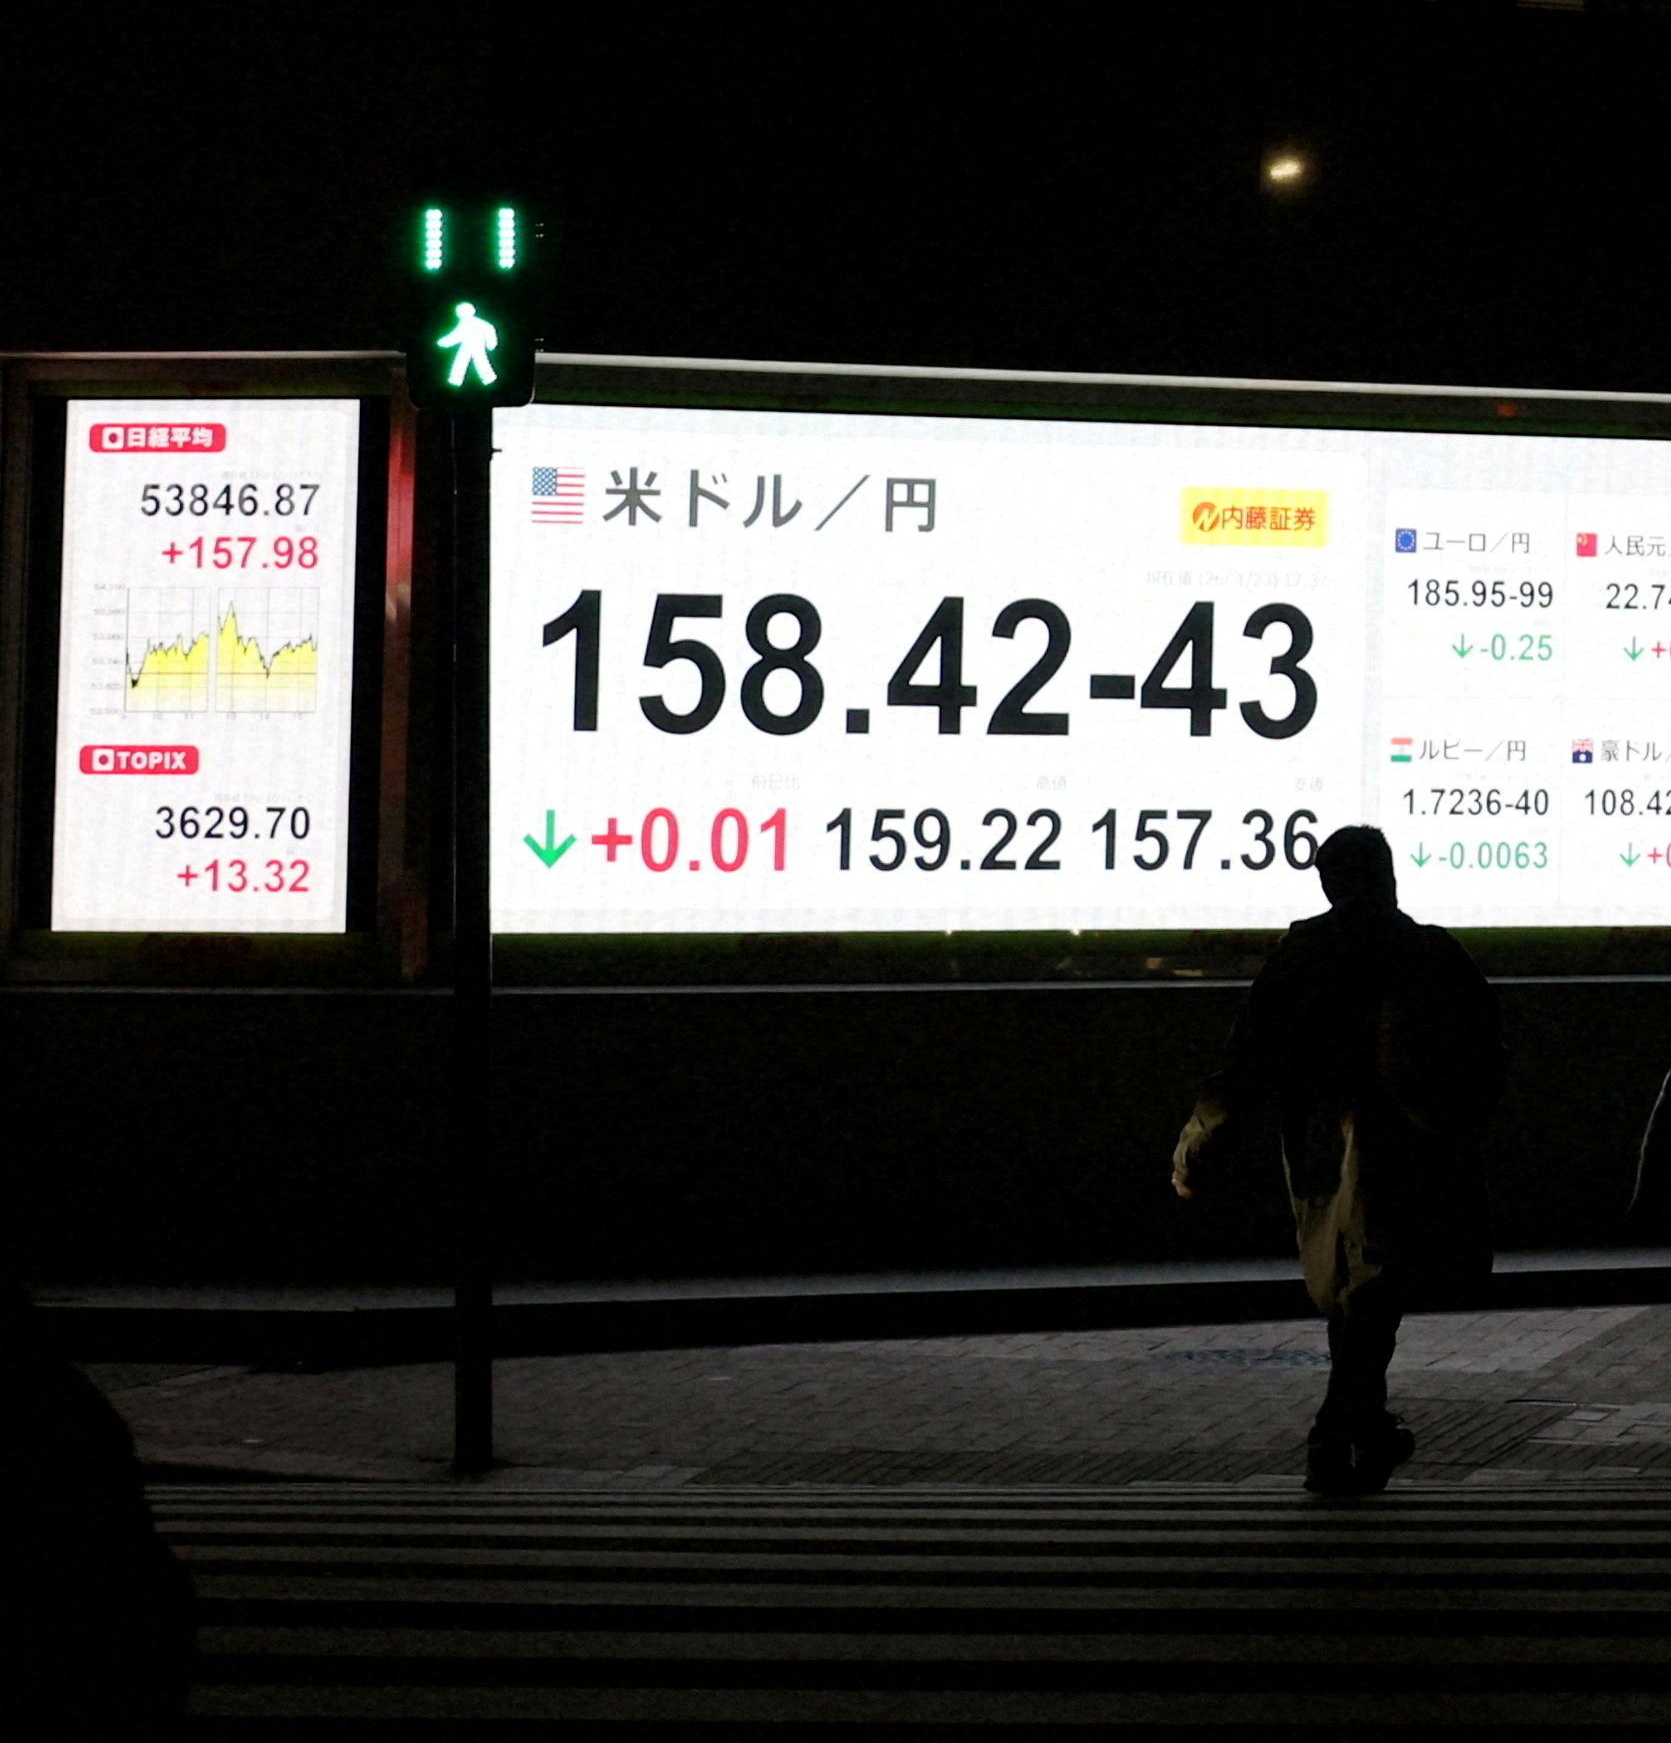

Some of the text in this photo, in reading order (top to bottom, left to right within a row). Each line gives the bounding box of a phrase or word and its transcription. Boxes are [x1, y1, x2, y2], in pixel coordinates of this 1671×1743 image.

[127, 426, 213, 448] 日経平均
[141, 483, 320, 517] 53846.87
[603, 467, 936, 532] 米ドル／円
[1221, 504, 1316, 531] 内藤証券
[162, 536, 318, 569] +157.98
[1424, 532, 1529, 553] ユーロ／円
[1408, 579, 1553, 608] 185.95-99
[1481, 634, 1552, 661] -0.25
[543, 590, 1317, 739] 158.42-43
[117, 752, 186, 770] TOPIX
[1419, 740, 1526, 761] ルビー／円
[1404, 789, 1549, 815] 1.7236-40
[155, 806, 310, 840] 3629.70
[591, 807, 1319, 872] +0.01 159.22 157.36
[1440, 842, 1547, 869] -0.0063
[177, 859, 309, 892] +13.32
